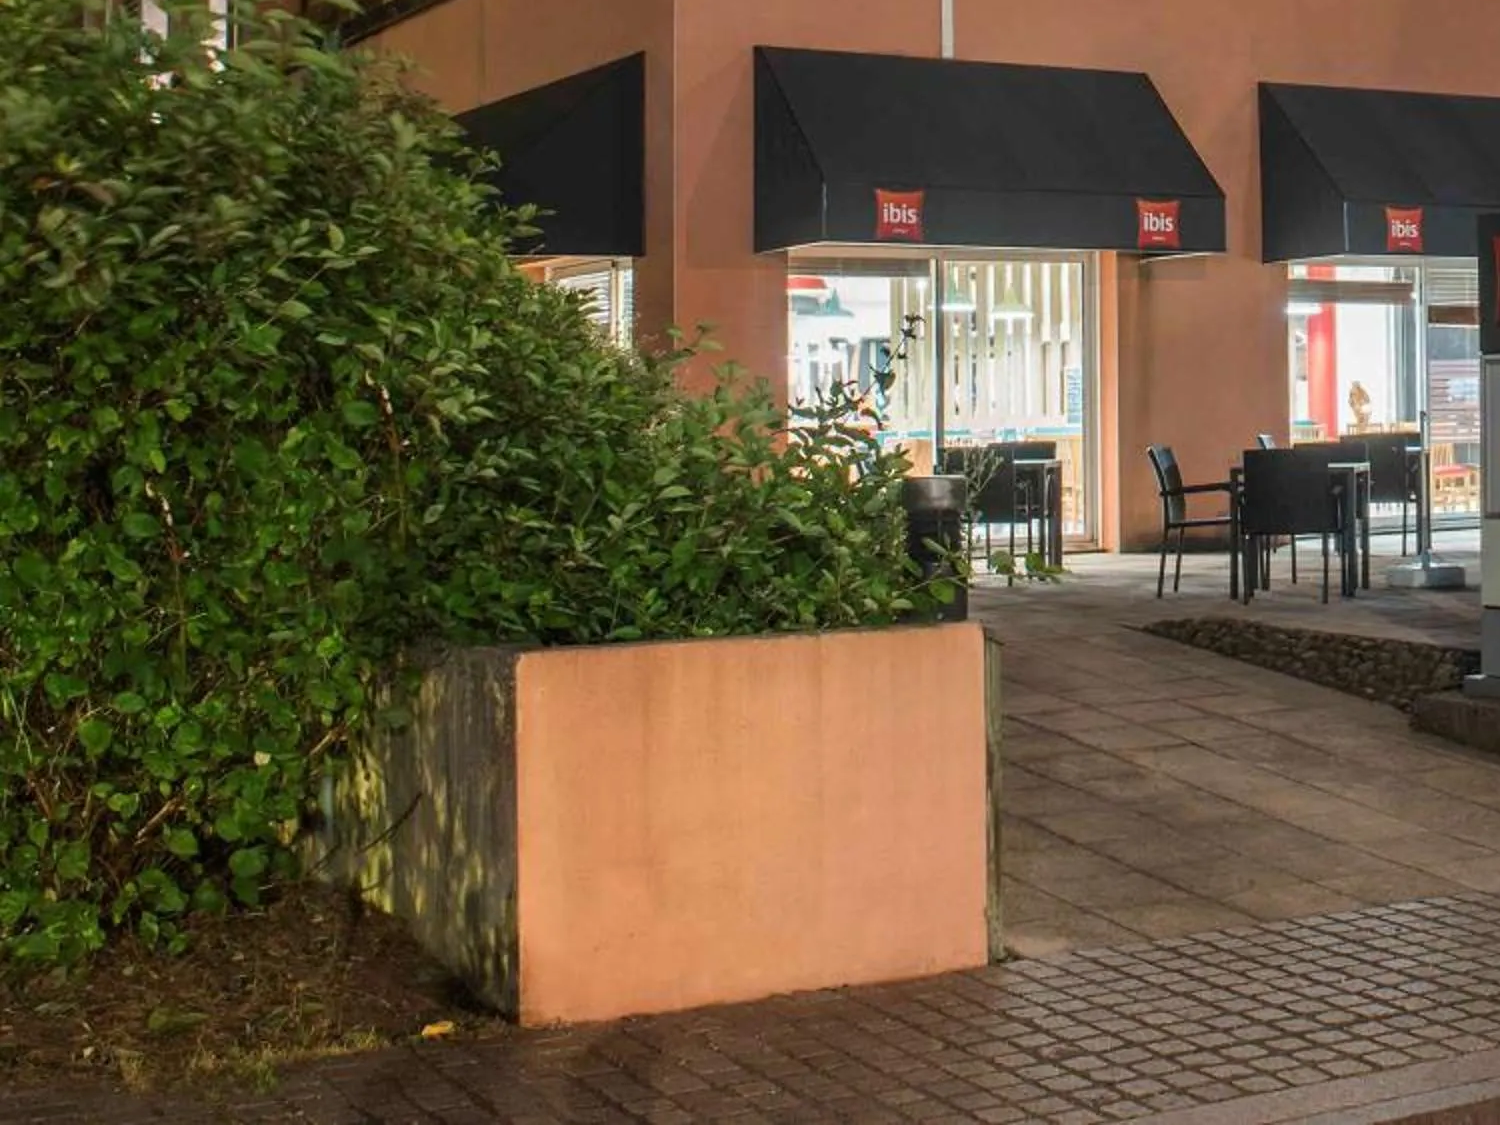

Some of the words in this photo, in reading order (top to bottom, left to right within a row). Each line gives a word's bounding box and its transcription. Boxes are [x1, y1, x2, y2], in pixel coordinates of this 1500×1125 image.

[882, 202, 918, 224] ibis
[1143, 212, 1174, 232] ibis
[1391, 219, 1419, 238] ibis
